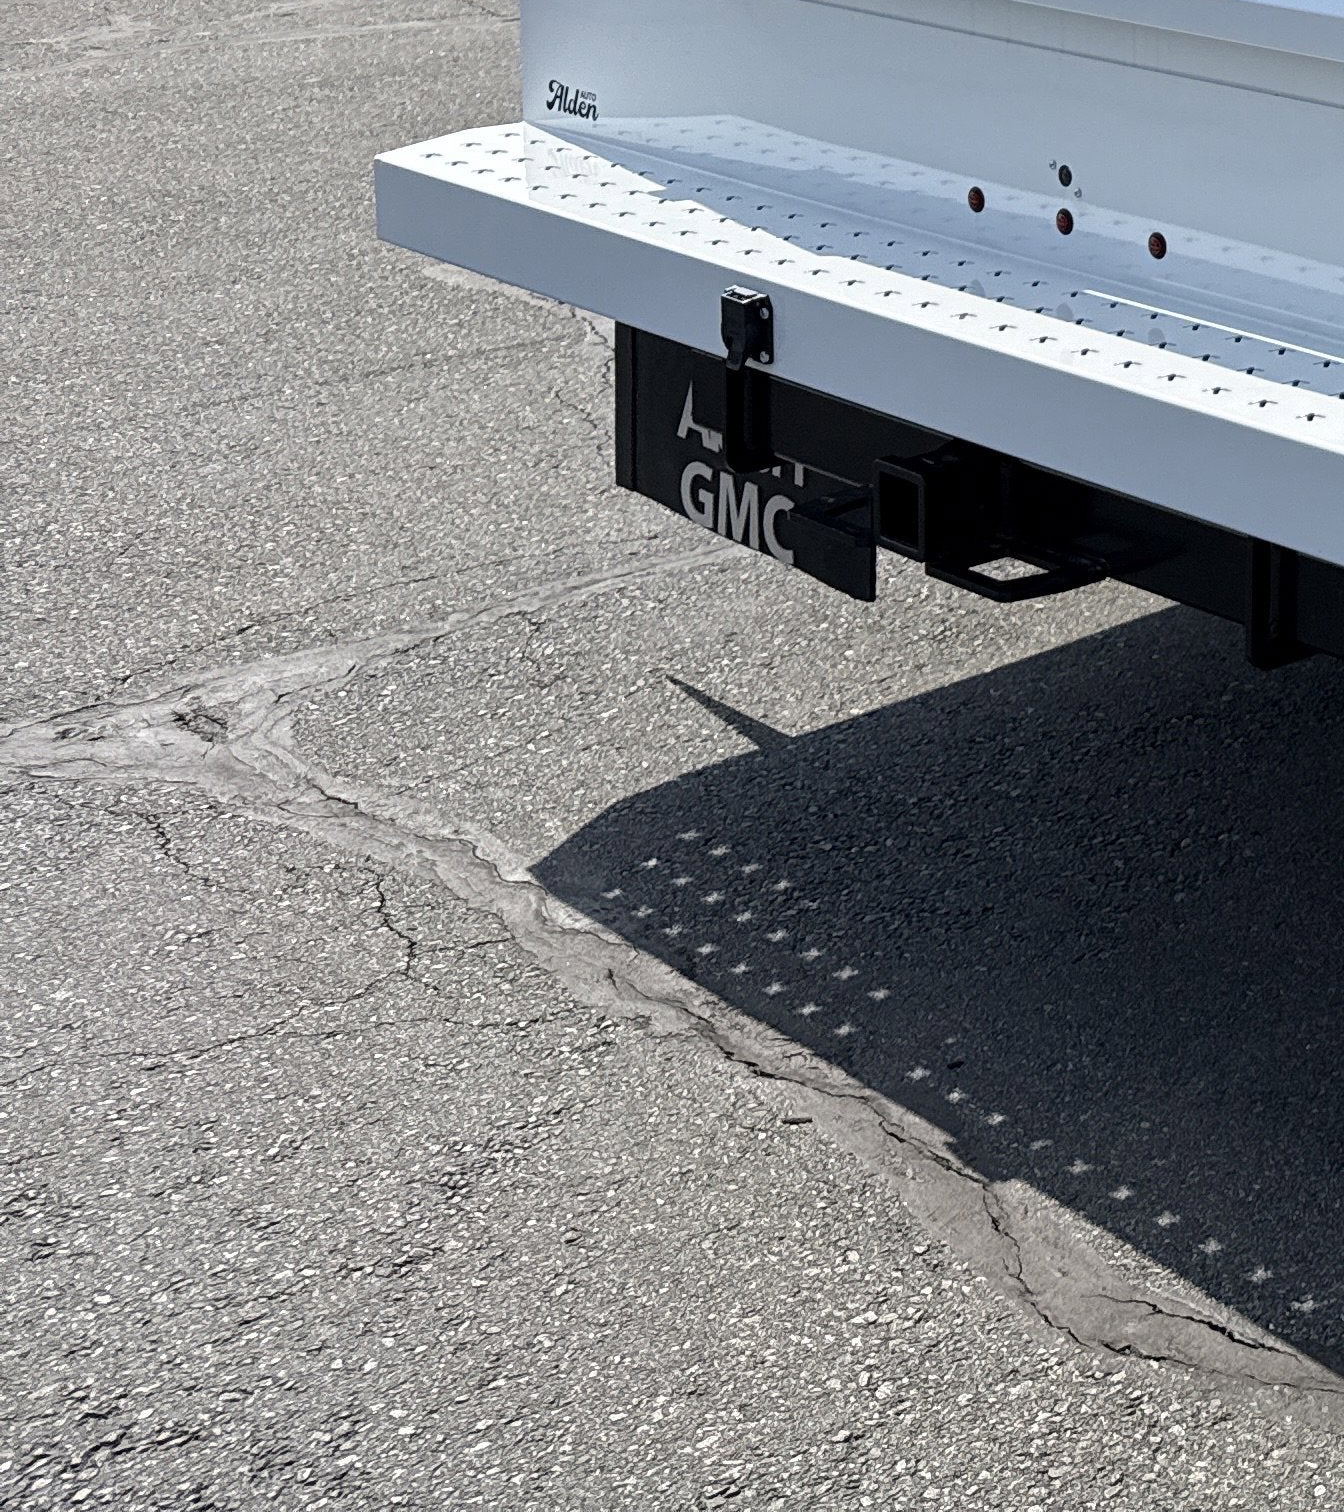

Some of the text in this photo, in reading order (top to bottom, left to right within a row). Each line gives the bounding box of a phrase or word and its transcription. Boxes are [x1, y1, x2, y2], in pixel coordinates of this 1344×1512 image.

[546, 79, 599, 121] Alden
[580, 90, 597, 101] AUTO
[680, 461, 795, 565] GMC
